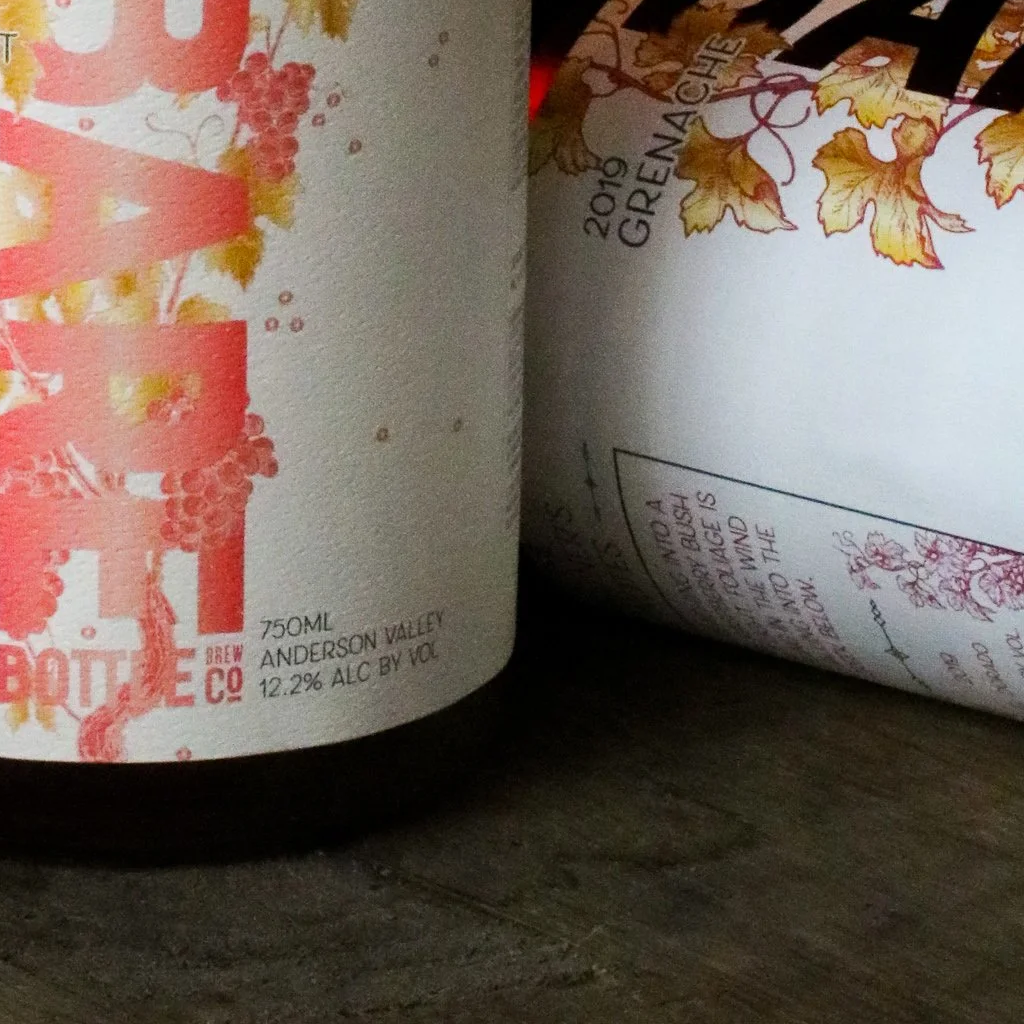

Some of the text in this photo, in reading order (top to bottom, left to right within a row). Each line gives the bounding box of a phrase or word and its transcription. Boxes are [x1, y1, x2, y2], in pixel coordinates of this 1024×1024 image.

[618, 35, 744, 248] GRENACHE
[583, 156, 628, 240] 2019
[670, 492, 701, 552] BUSH
[696, 490, 717, 512] IS
[728, 515, 757, 571] WIND
[755, 523, 780, 564] THE
[260, 611, 333, 640] 750ML
[260, 610, 444, 669] ANDERSON VALLEY
[205, 643, 243, 665] BREW
[259, 641, 438, 698] 12.2% ALC BY VOL
